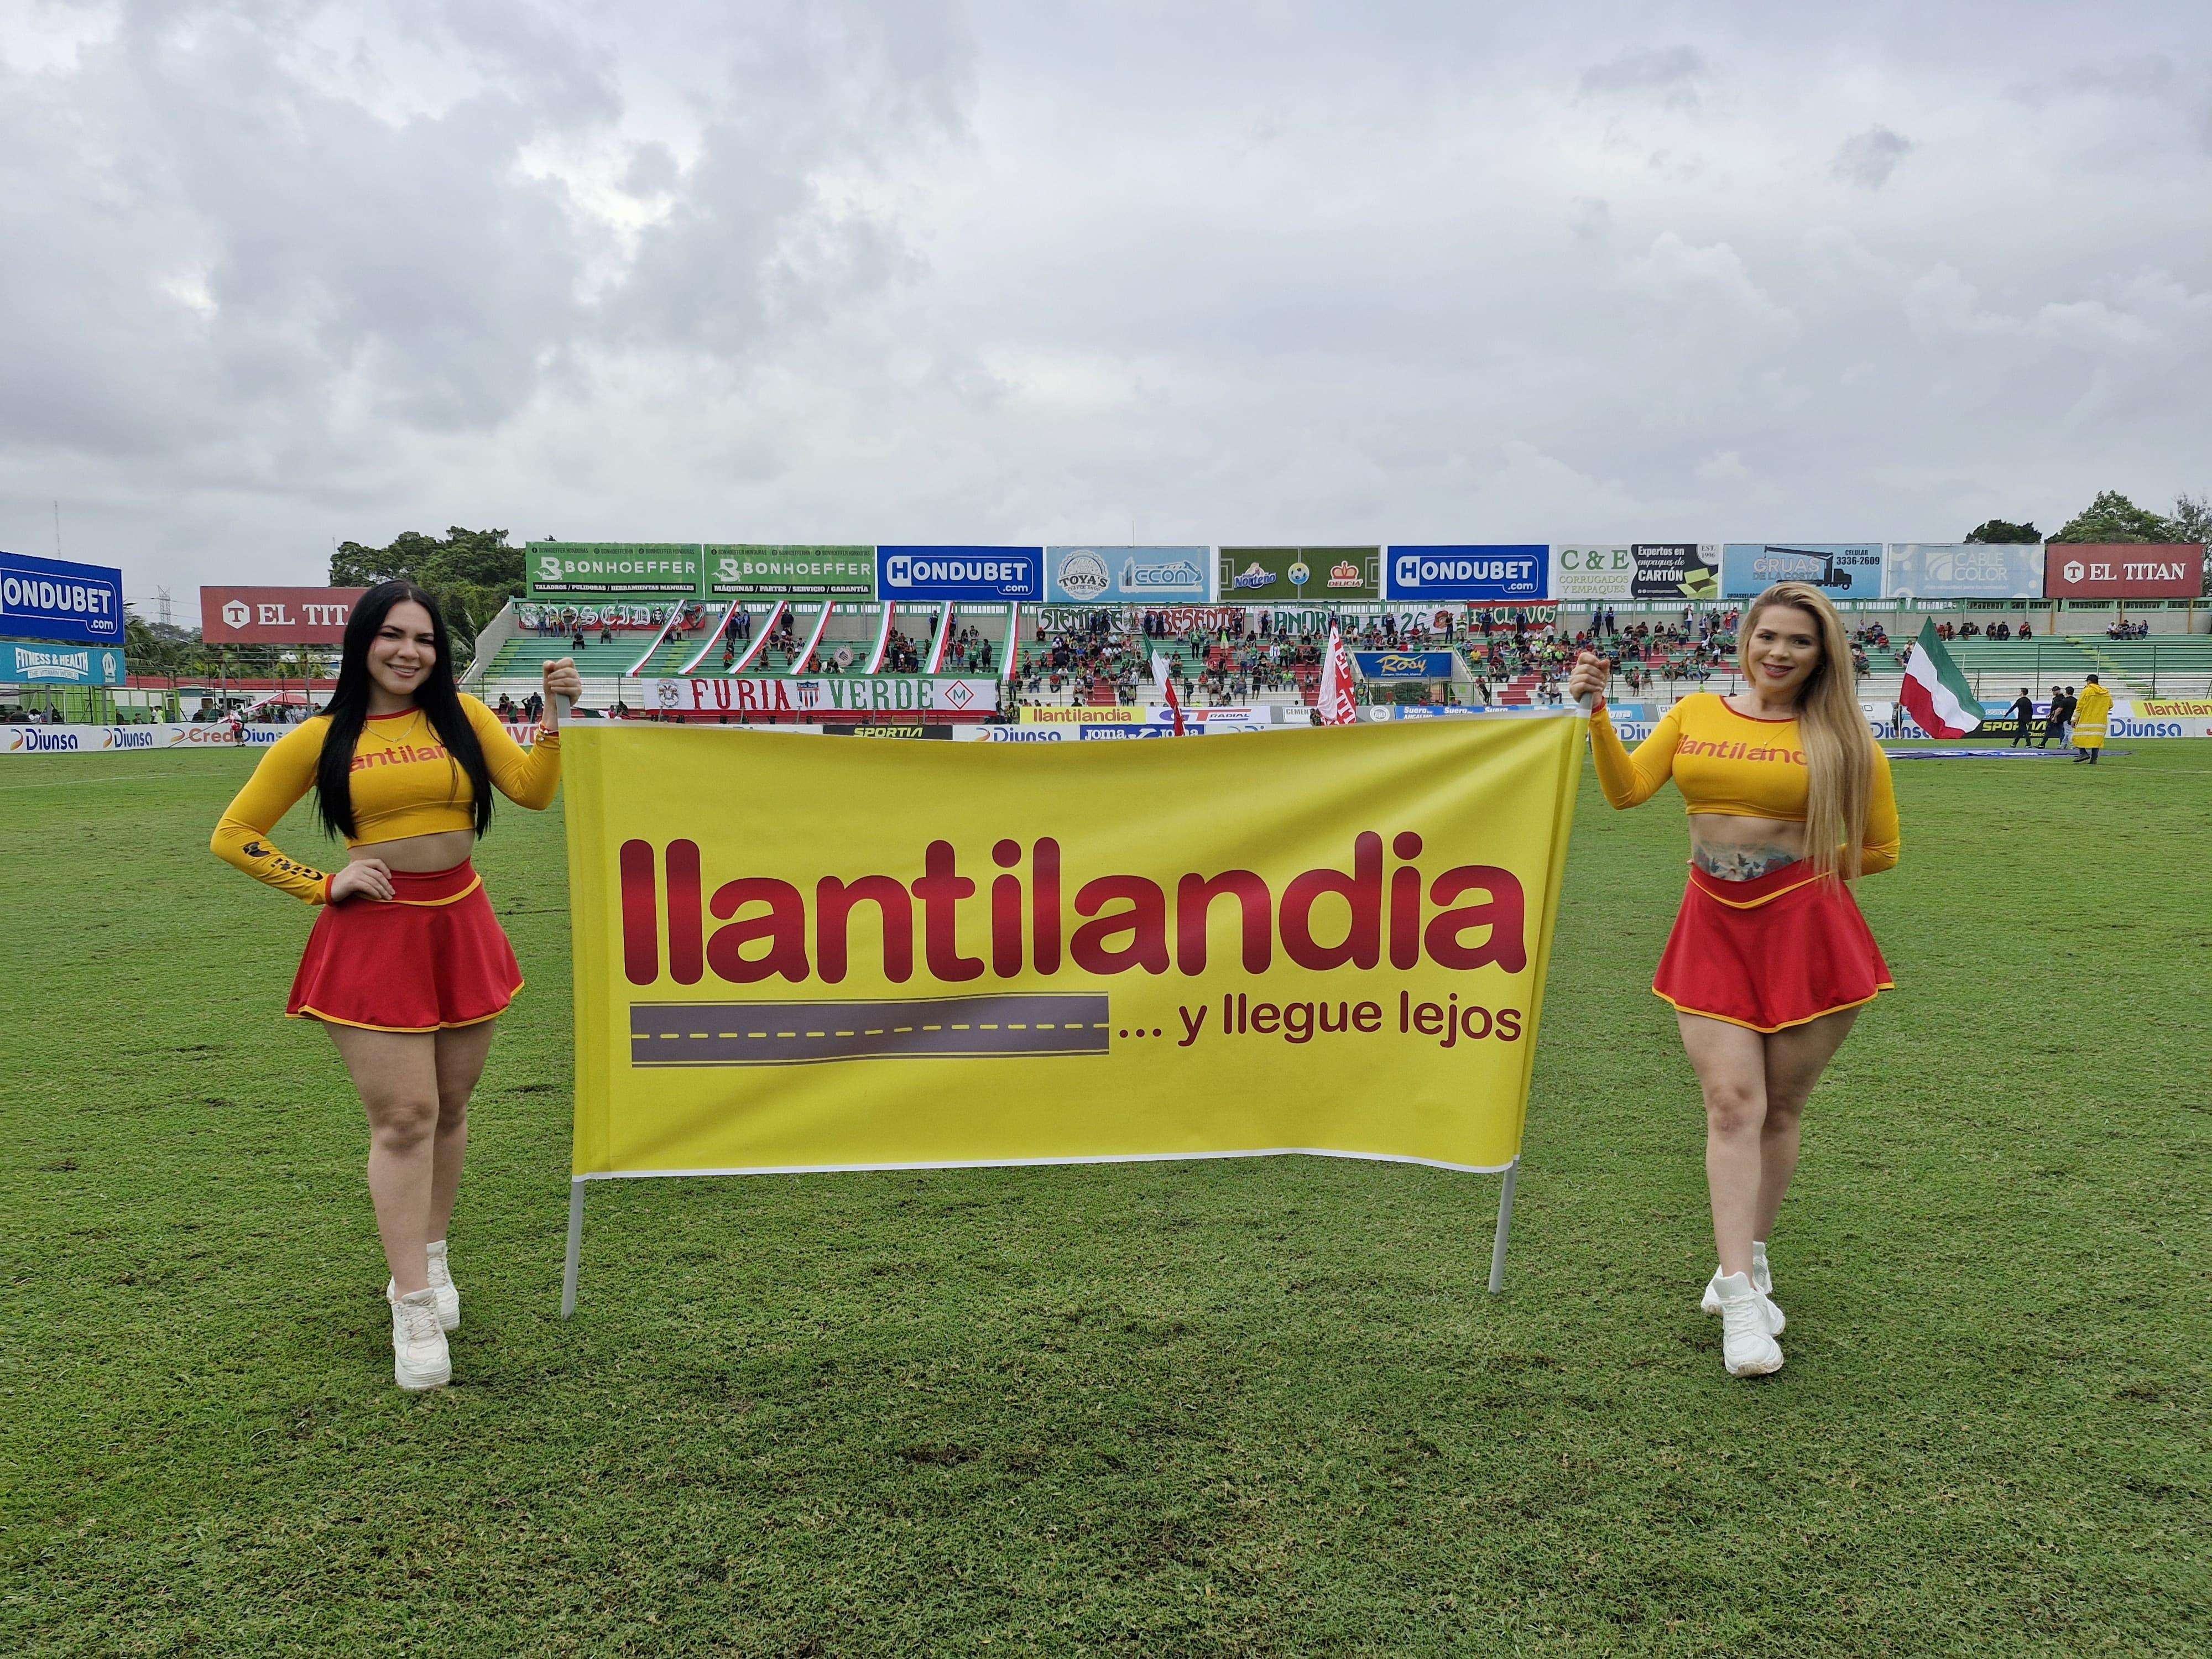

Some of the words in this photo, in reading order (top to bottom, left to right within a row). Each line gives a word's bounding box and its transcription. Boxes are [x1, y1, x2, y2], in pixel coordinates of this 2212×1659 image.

[1638, 546, 1673, 557] Expertos
[1561, 550, 1580, 570] C
[1585, 550, 1605, 570] &
[1611, 550, 1630, 570] E
[1637, 559, 1673, 568] empaques
[1674, 557, 1685, 566] de
[1753, 557, 1820, 572] GRUAS
[1836, 556, 1880, 565] 3336-2609
[1955, 553, 2005, 566] CABLE
[565, 561, 696, 573] BONHOEFFER
[743, 562, 870, 575] BONHOEFFER
[891, 561, 1027, 581] HONDUBET
[1400, 561, 1532, 581] HONDUBET
[1638, 567, 1683, 581] CARTÓN
[1954, 567, 2008, 581] COLOR
[2089, 563, 2117, 580] EL
[2124, 563, 2185, 580] TITAN
[1058, 575, 1108, 587] TOYA'S
[1559, 575, 1629, 584] CORRUGADOS
[1752, 572, 1765, 581] DE
[1783, 572, 1819, 580] COSTA
[3, 577, 111, 614] ONDUBET
[1571, 585, 1625, 594] EMPAQUES
[257, 604, 295, 625] EL
[302, 604, 349, 625] TIT
[1470, 605, 1556, 625] ECLVOS
[91, 619, 113, 630] .com
[15, 647, 51, 669] FITNESS
[52, 654, 59, 664] &
[59, 651, 88, 672] HEALTH
[1375, 654, 1427, 673] Rosy
[60, 671, 78, 679] WORLD
[690, 679, 791, 709] FURIA
[827, 679, 934, 709] VERDE
[953, 690, 966, 701] M
[1033, 708, 1132, 722] llantilandia
[2143, 702, 2212, 716] llantilan
[853, 727, 924, 737] SPORTIA
[1621, 723, 1652, 740] Diu
[1982, 721, 2048, 732] SPORIA
[2110, 719, 2182, 737] Diunsa
[25, 728, 78, 750] Diunsa
[114, 727, 153, 748] Diunsa
[994, 727, 1061, 742] Diunsa
[619, 831, 1527, 985] llantilandia
[1178, 1004, 1208, 1047] y
[1224, 993, 1383, 1044] llegue
[1399, 990, 1522, 1048] lejos
